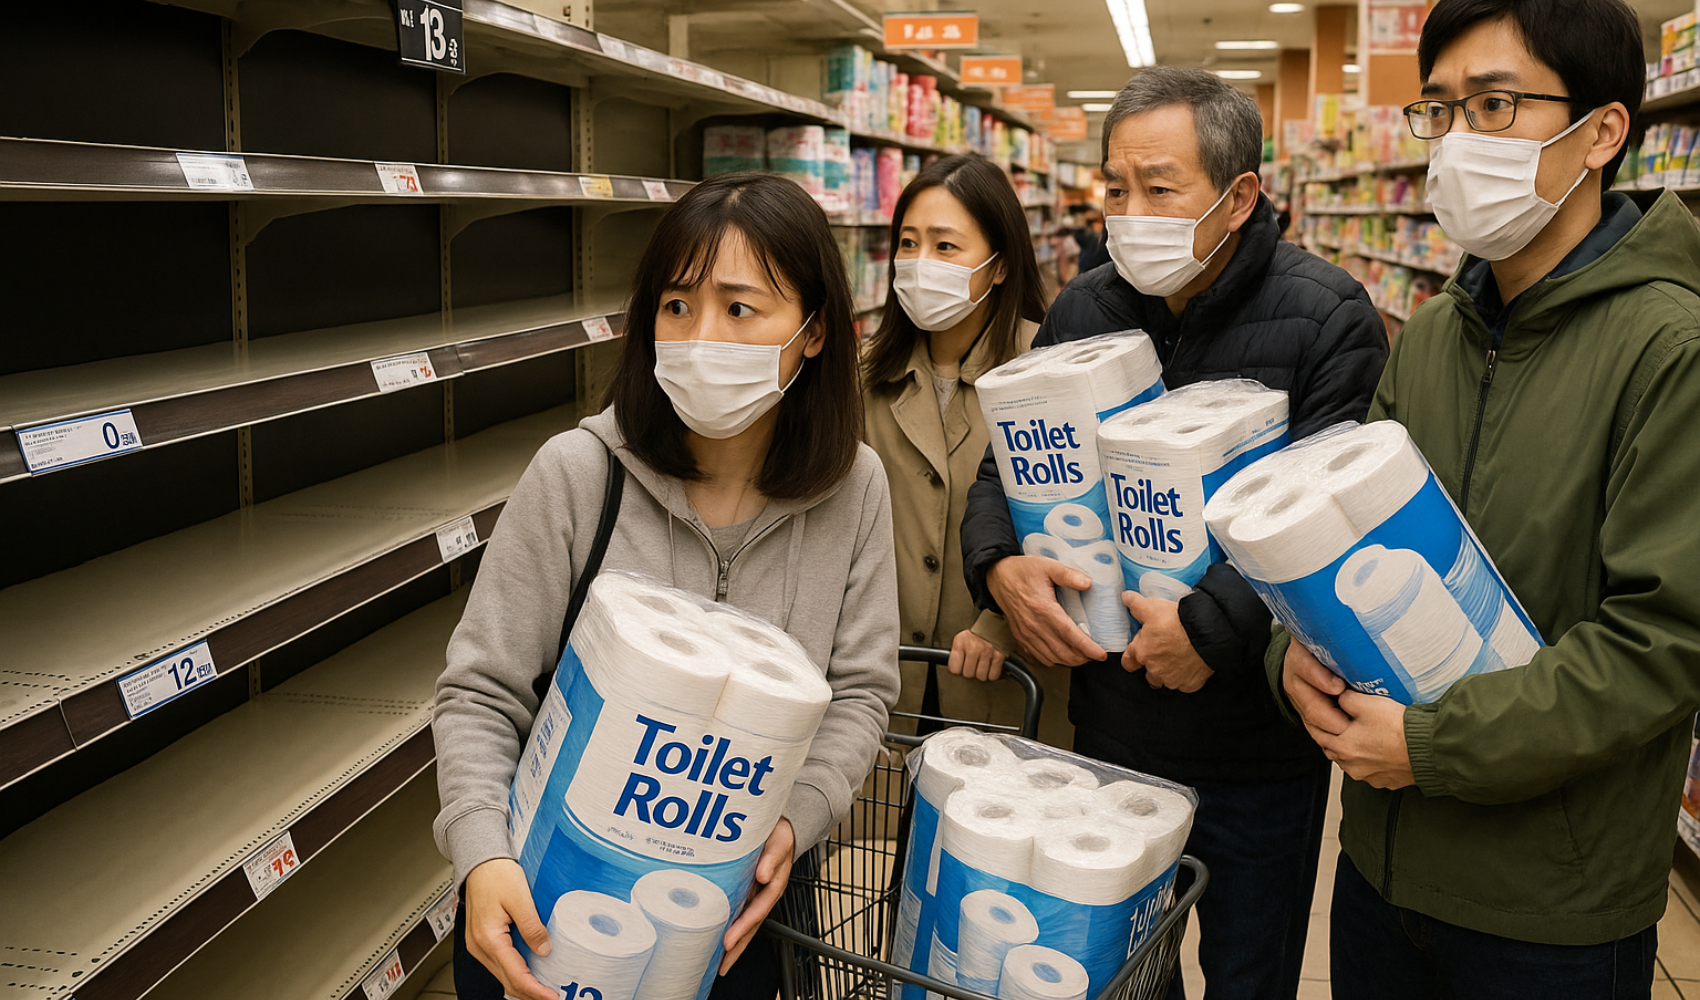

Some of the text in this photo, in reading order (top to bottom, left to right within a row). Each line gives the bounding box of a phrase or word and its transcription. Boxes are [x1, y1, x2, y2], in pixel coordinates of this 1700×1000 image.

[420, 4, 447, 61] 13
[102, 421, 120, 449] 0
[997, 419, 1081, 453] Toilet
[1010, 453, 1084, 486] Rolls
[1110, 473, 1184, 518] Toilet
[1118, 511, 1185, 554] Rolls
[167, 656, 198, 691] 12
[633, 713, 775, 796] Toilet
[612, 772, 748, 843] Rolls
